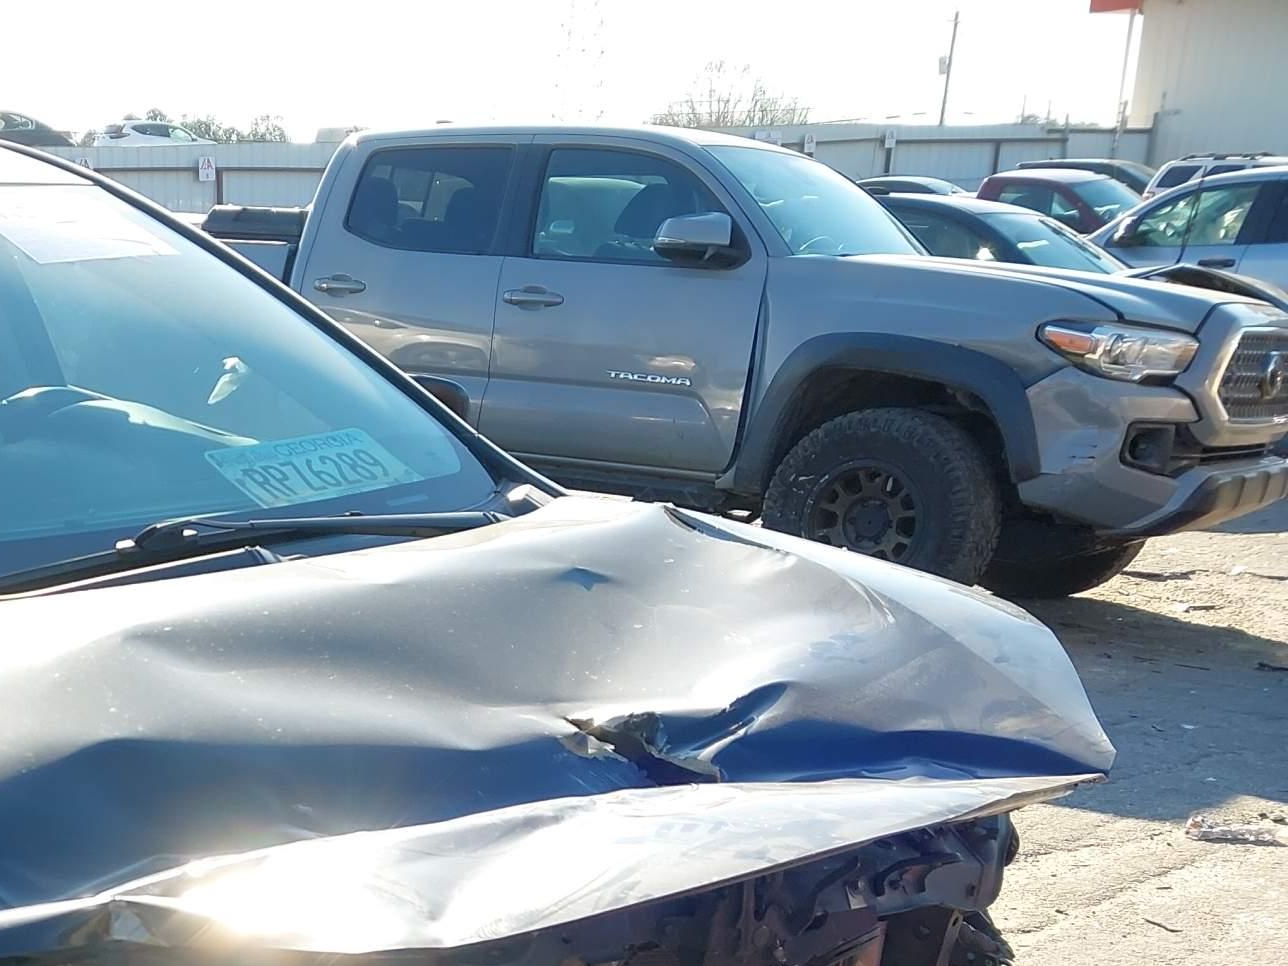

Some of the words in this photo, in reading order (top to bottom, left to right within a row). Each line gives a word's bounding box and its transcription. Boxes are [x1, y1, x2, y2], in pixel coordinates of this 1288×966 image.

[607, 369, 692, 386] TACOMA
[273, 433, 363, 457] GEORGIA
[240, 449, 390, 500] RPZ6289
